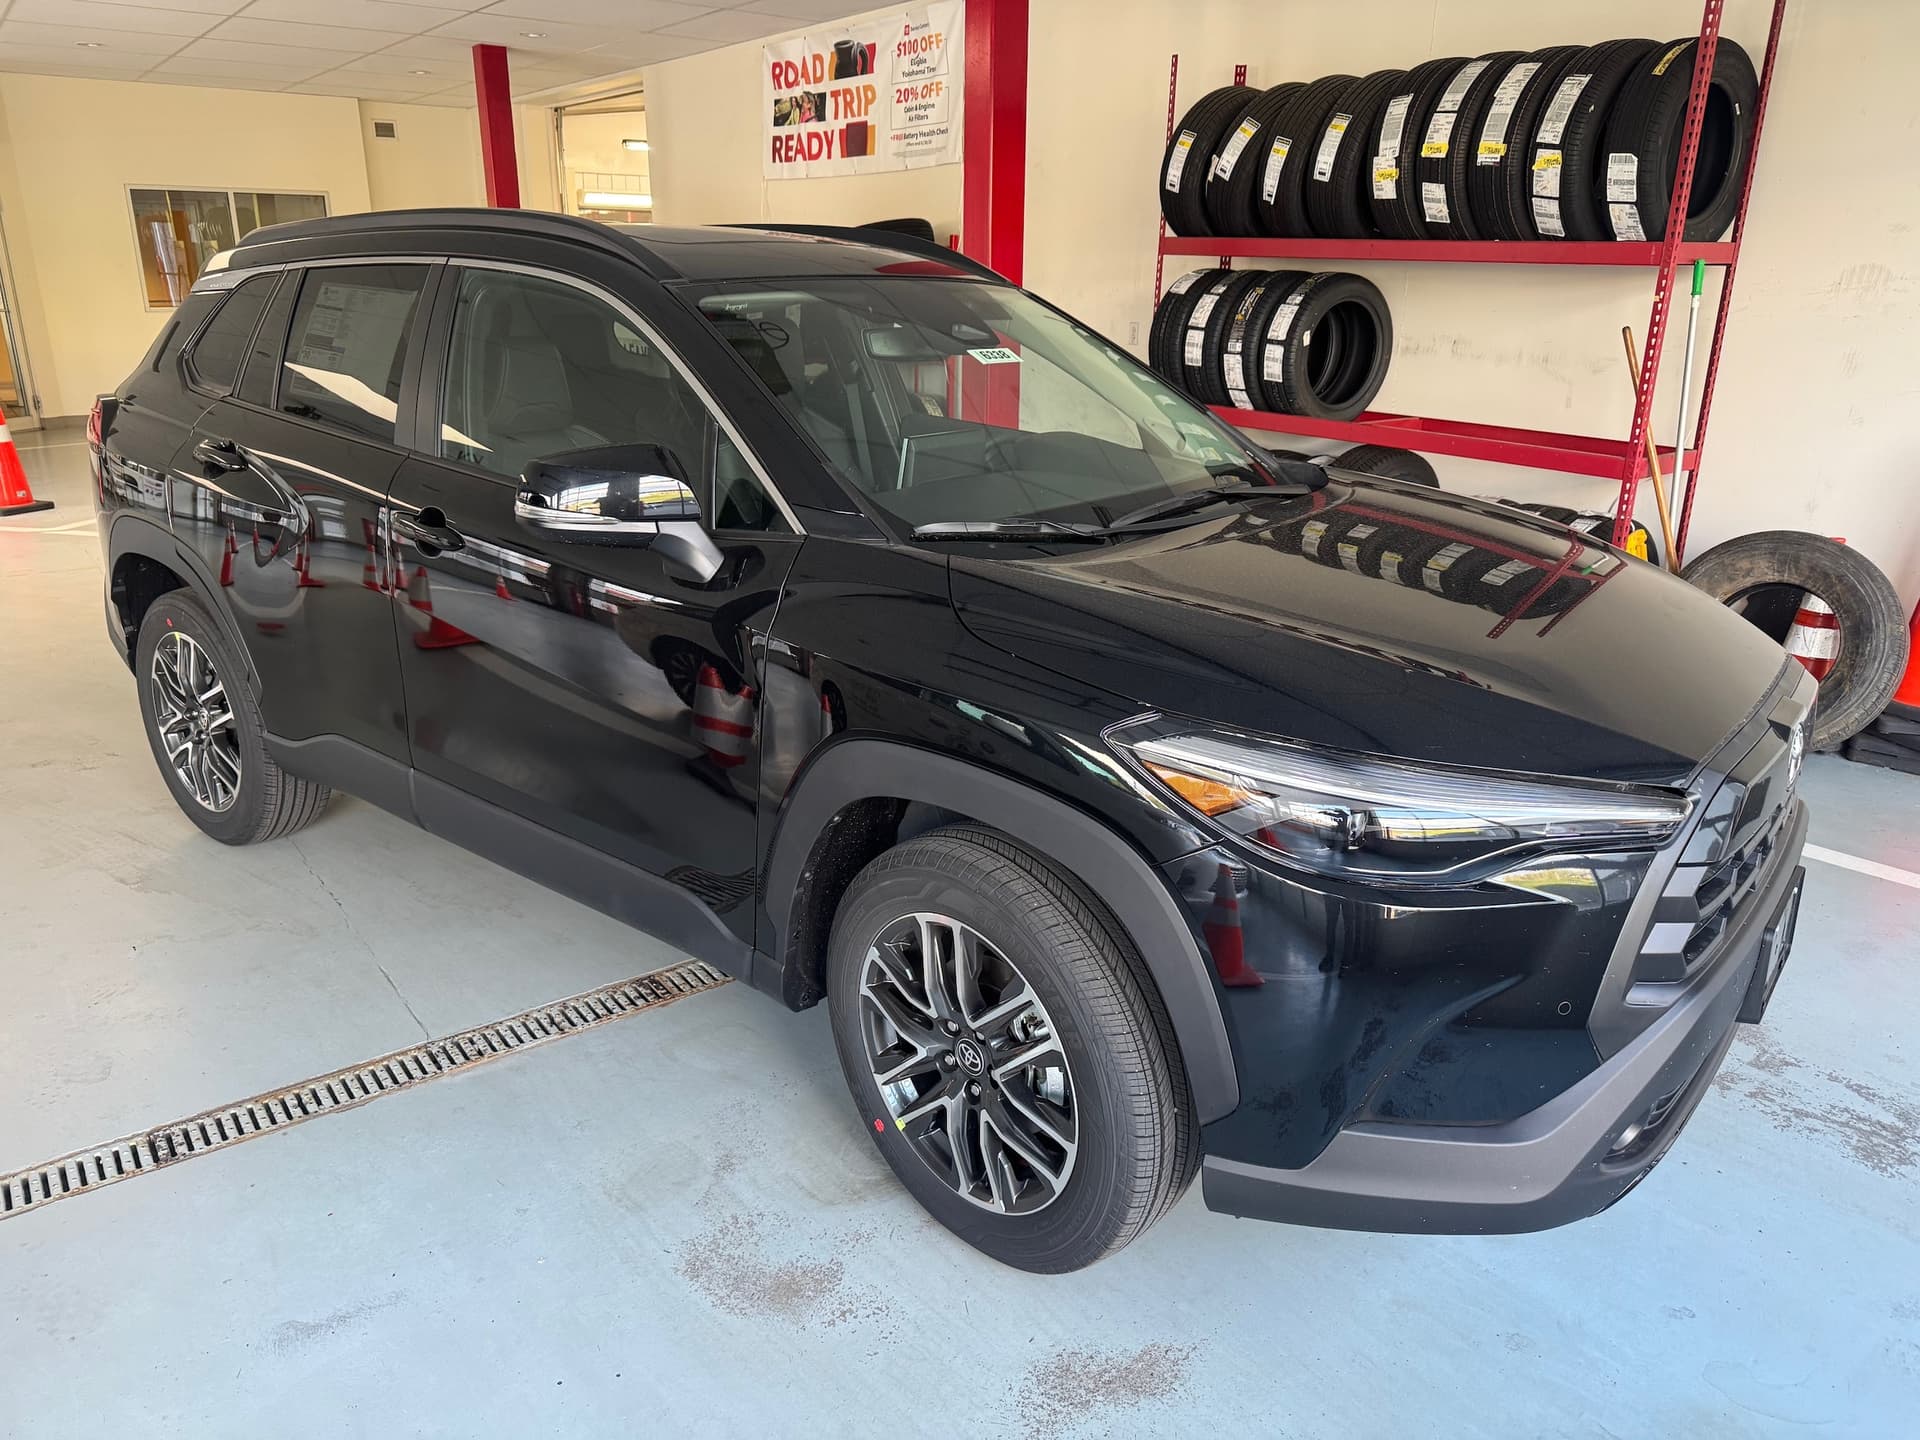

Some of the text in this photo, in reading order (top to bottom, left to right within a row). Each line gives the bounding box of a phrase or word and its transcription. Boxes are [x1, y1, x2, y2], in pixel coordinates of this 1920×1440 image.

[897, 32, 943, 59] $100 OFF
[771, 53, 824, 91] ROAD
[830, 84, 877, 121] TRIP
[895, 80, 943, 104] 20% OFF
[914, 113, 929, 121] Filters
[918, 102, 936, 112] Engine
[903, 131, 918, 141] Battery
[919, 129, 936, 138] Health
[936, 127, 949, 135] Check
[772, 129, 835, 164] READY
[979, 350, 1011, 360] 6338
